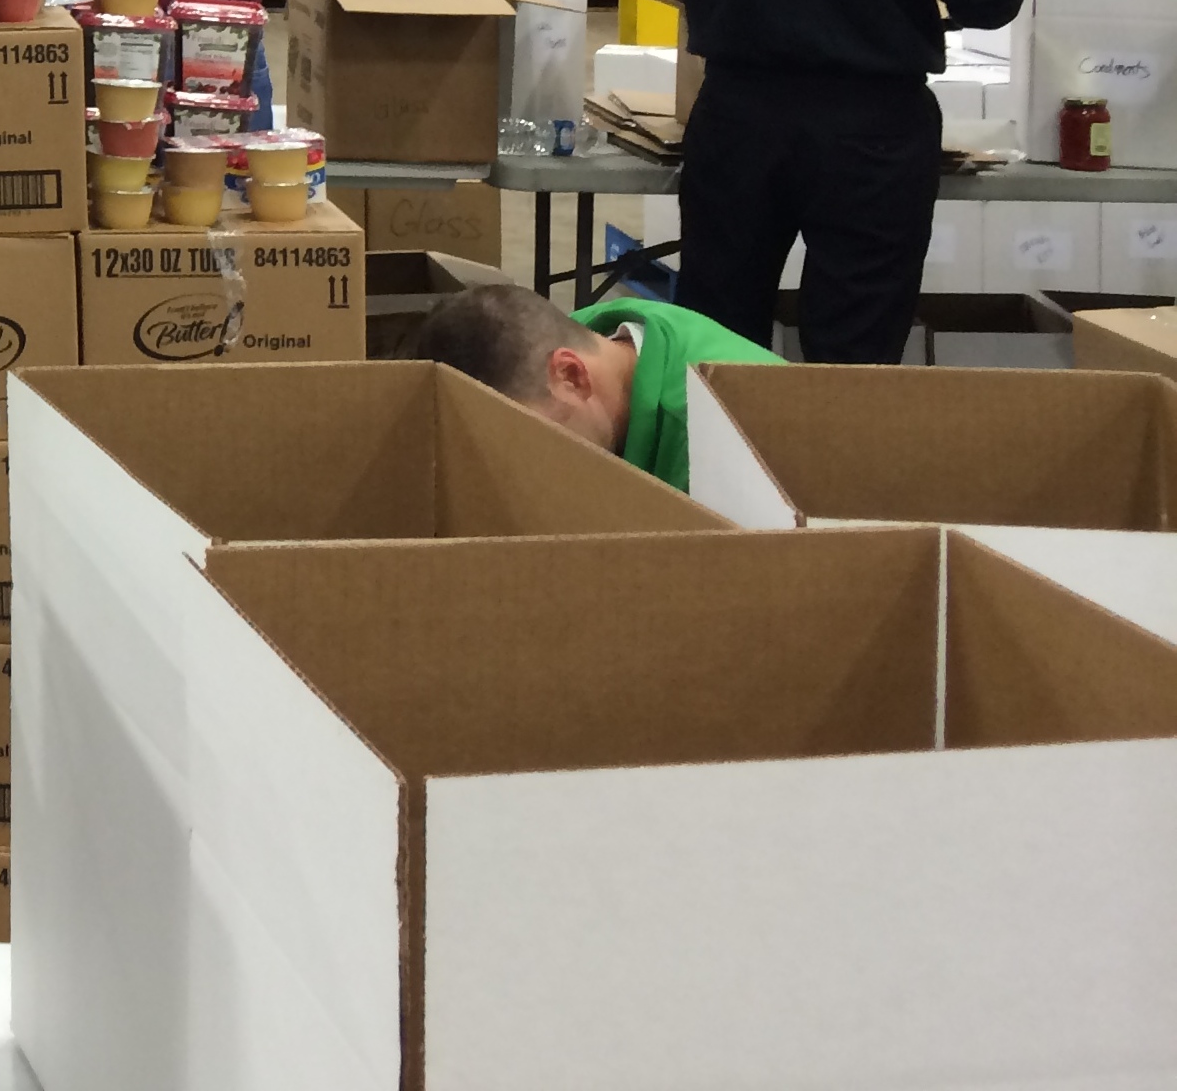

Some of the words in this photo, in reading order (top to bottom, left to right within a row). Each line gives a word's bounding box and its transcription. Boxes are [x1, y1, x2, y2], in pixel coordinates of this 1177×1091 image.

[389, 197, 484, 240] Glass
[91, 247, 154, 278] 12x30
[160, 247, 182, 273] OZ
[188, 247, 236, 273] TUBS
[254, 246, 351, 268] 84114863
[243, 333, 311, 351] Original
